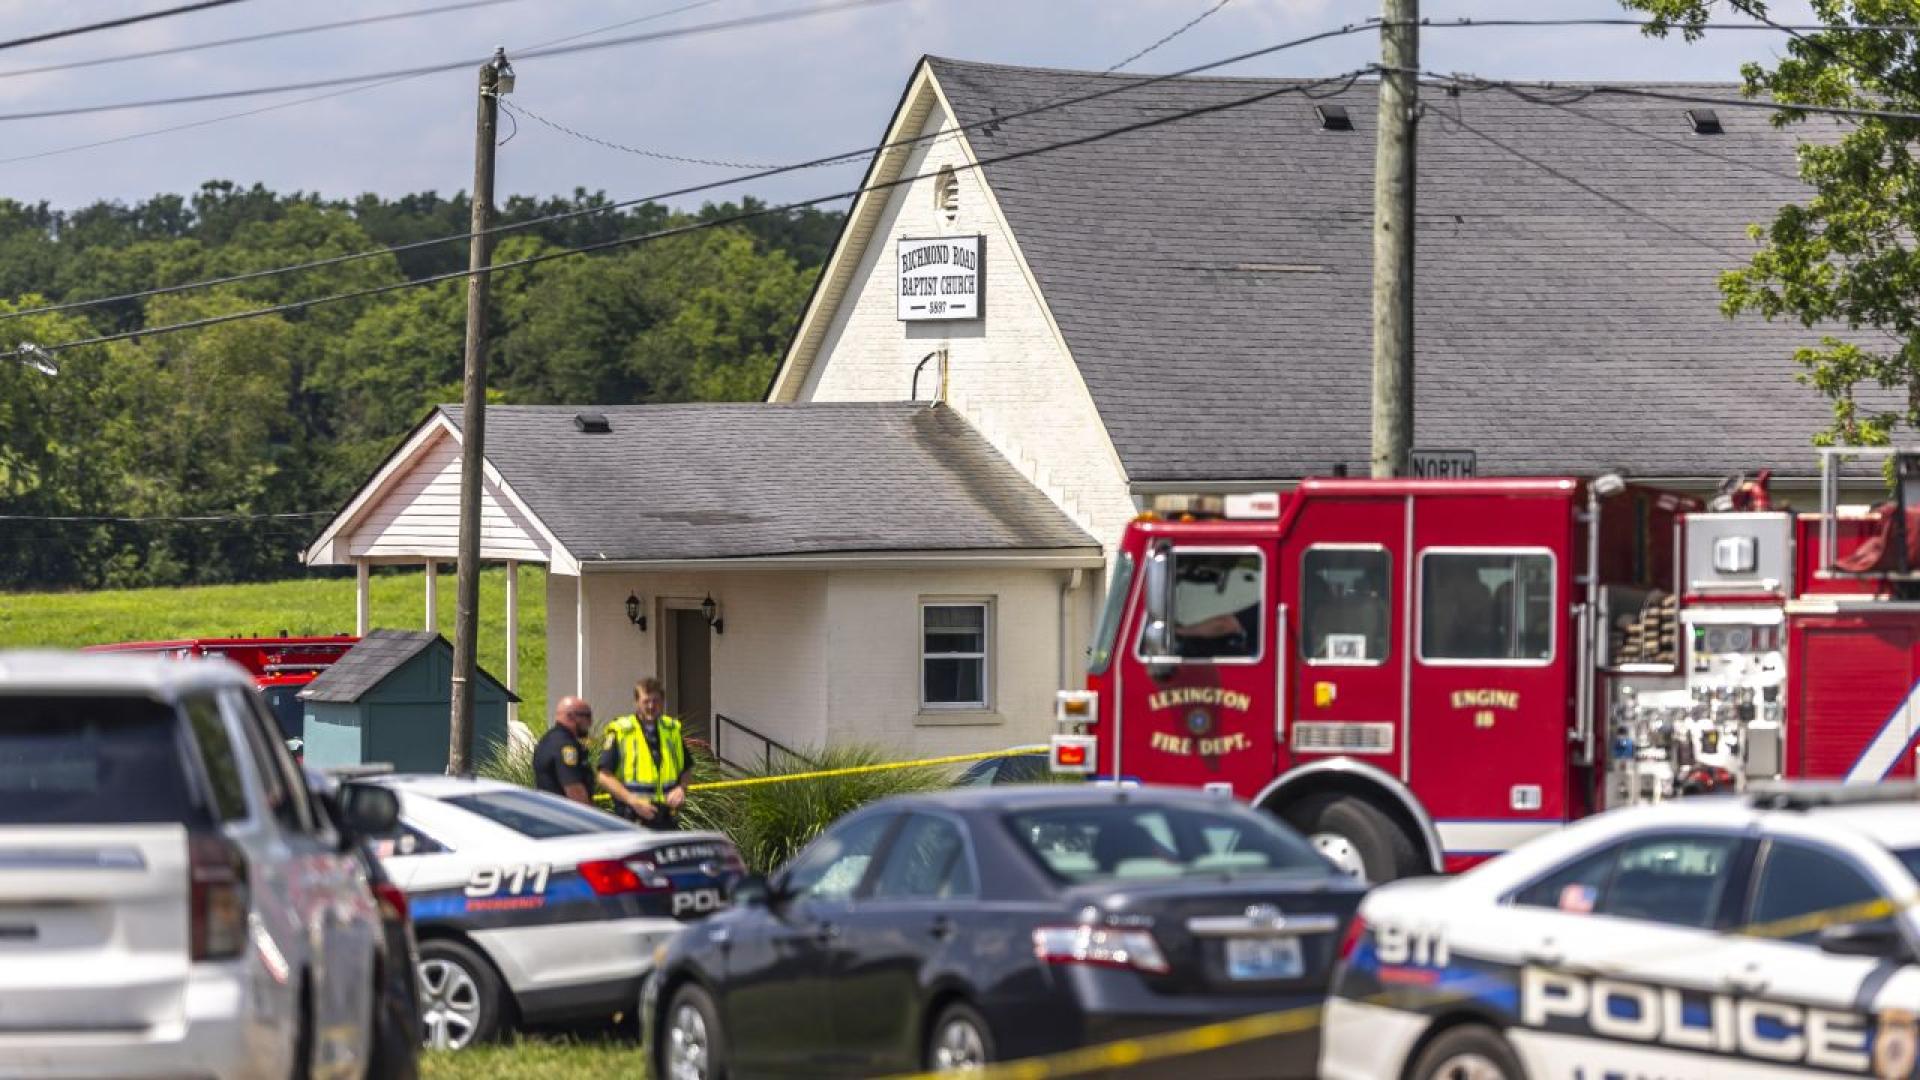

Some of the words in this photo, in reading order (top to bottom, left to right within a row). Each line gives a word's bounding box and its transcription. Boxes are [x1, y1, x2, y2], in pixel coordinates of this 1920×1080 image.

[901, 244, 949, 273] RICHMOND
[952, 245, 976, 270] ROAD
[902, 276, 937, 296] BAPTIST
[941, 274, 976, 294] CHURCH
[1413, 458, 1472, 480] NORTH
[1149, 687, 1251, 712] LEXINGTON
[1451, 689, 1520, 710] ENGINE
[1152, 732, 1193, 755] FIRE
[1200, 732, 1253, 755] DEPT.
[464, 863, 551, 897] 911
[1376, 920, 1452, 967] 911
[1521, 966, 1871, 1069] POLICE
